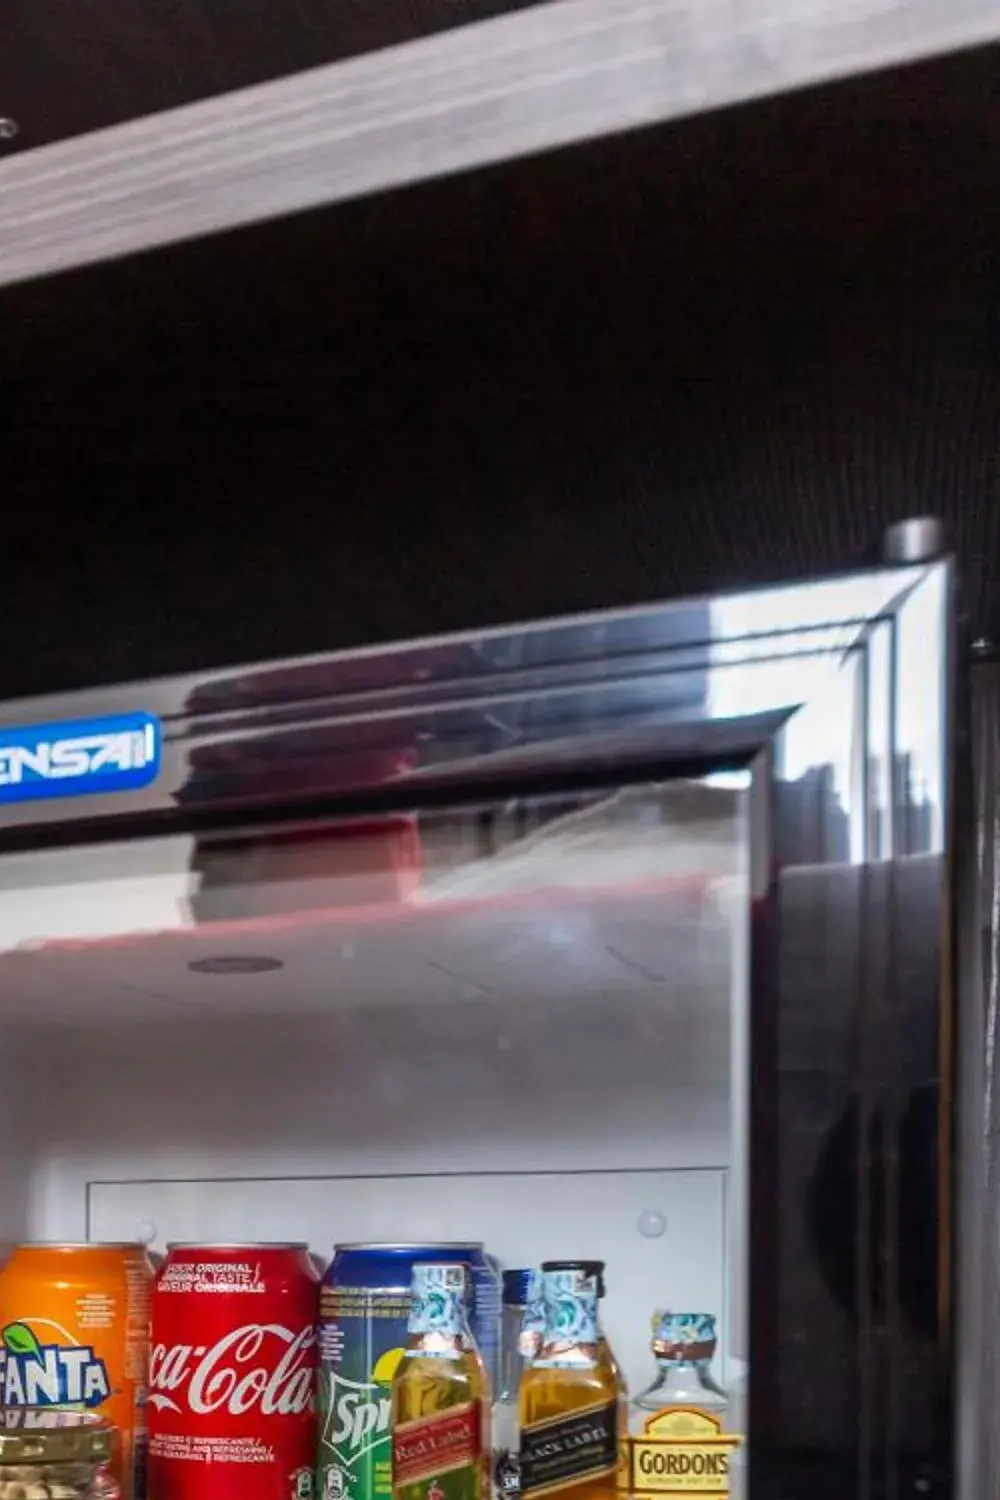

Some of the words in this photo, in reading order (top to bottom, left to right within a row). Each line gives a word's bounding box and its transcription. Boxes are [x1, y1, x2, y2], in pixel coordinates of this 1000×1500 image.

[195, 1263, 253, 1273] ORIGINAL
[212, 1273, 252, 1283] TASTE
[331, 1393, 393, 1450] Spr
[563, 1426, 608, 1449] LABEL
